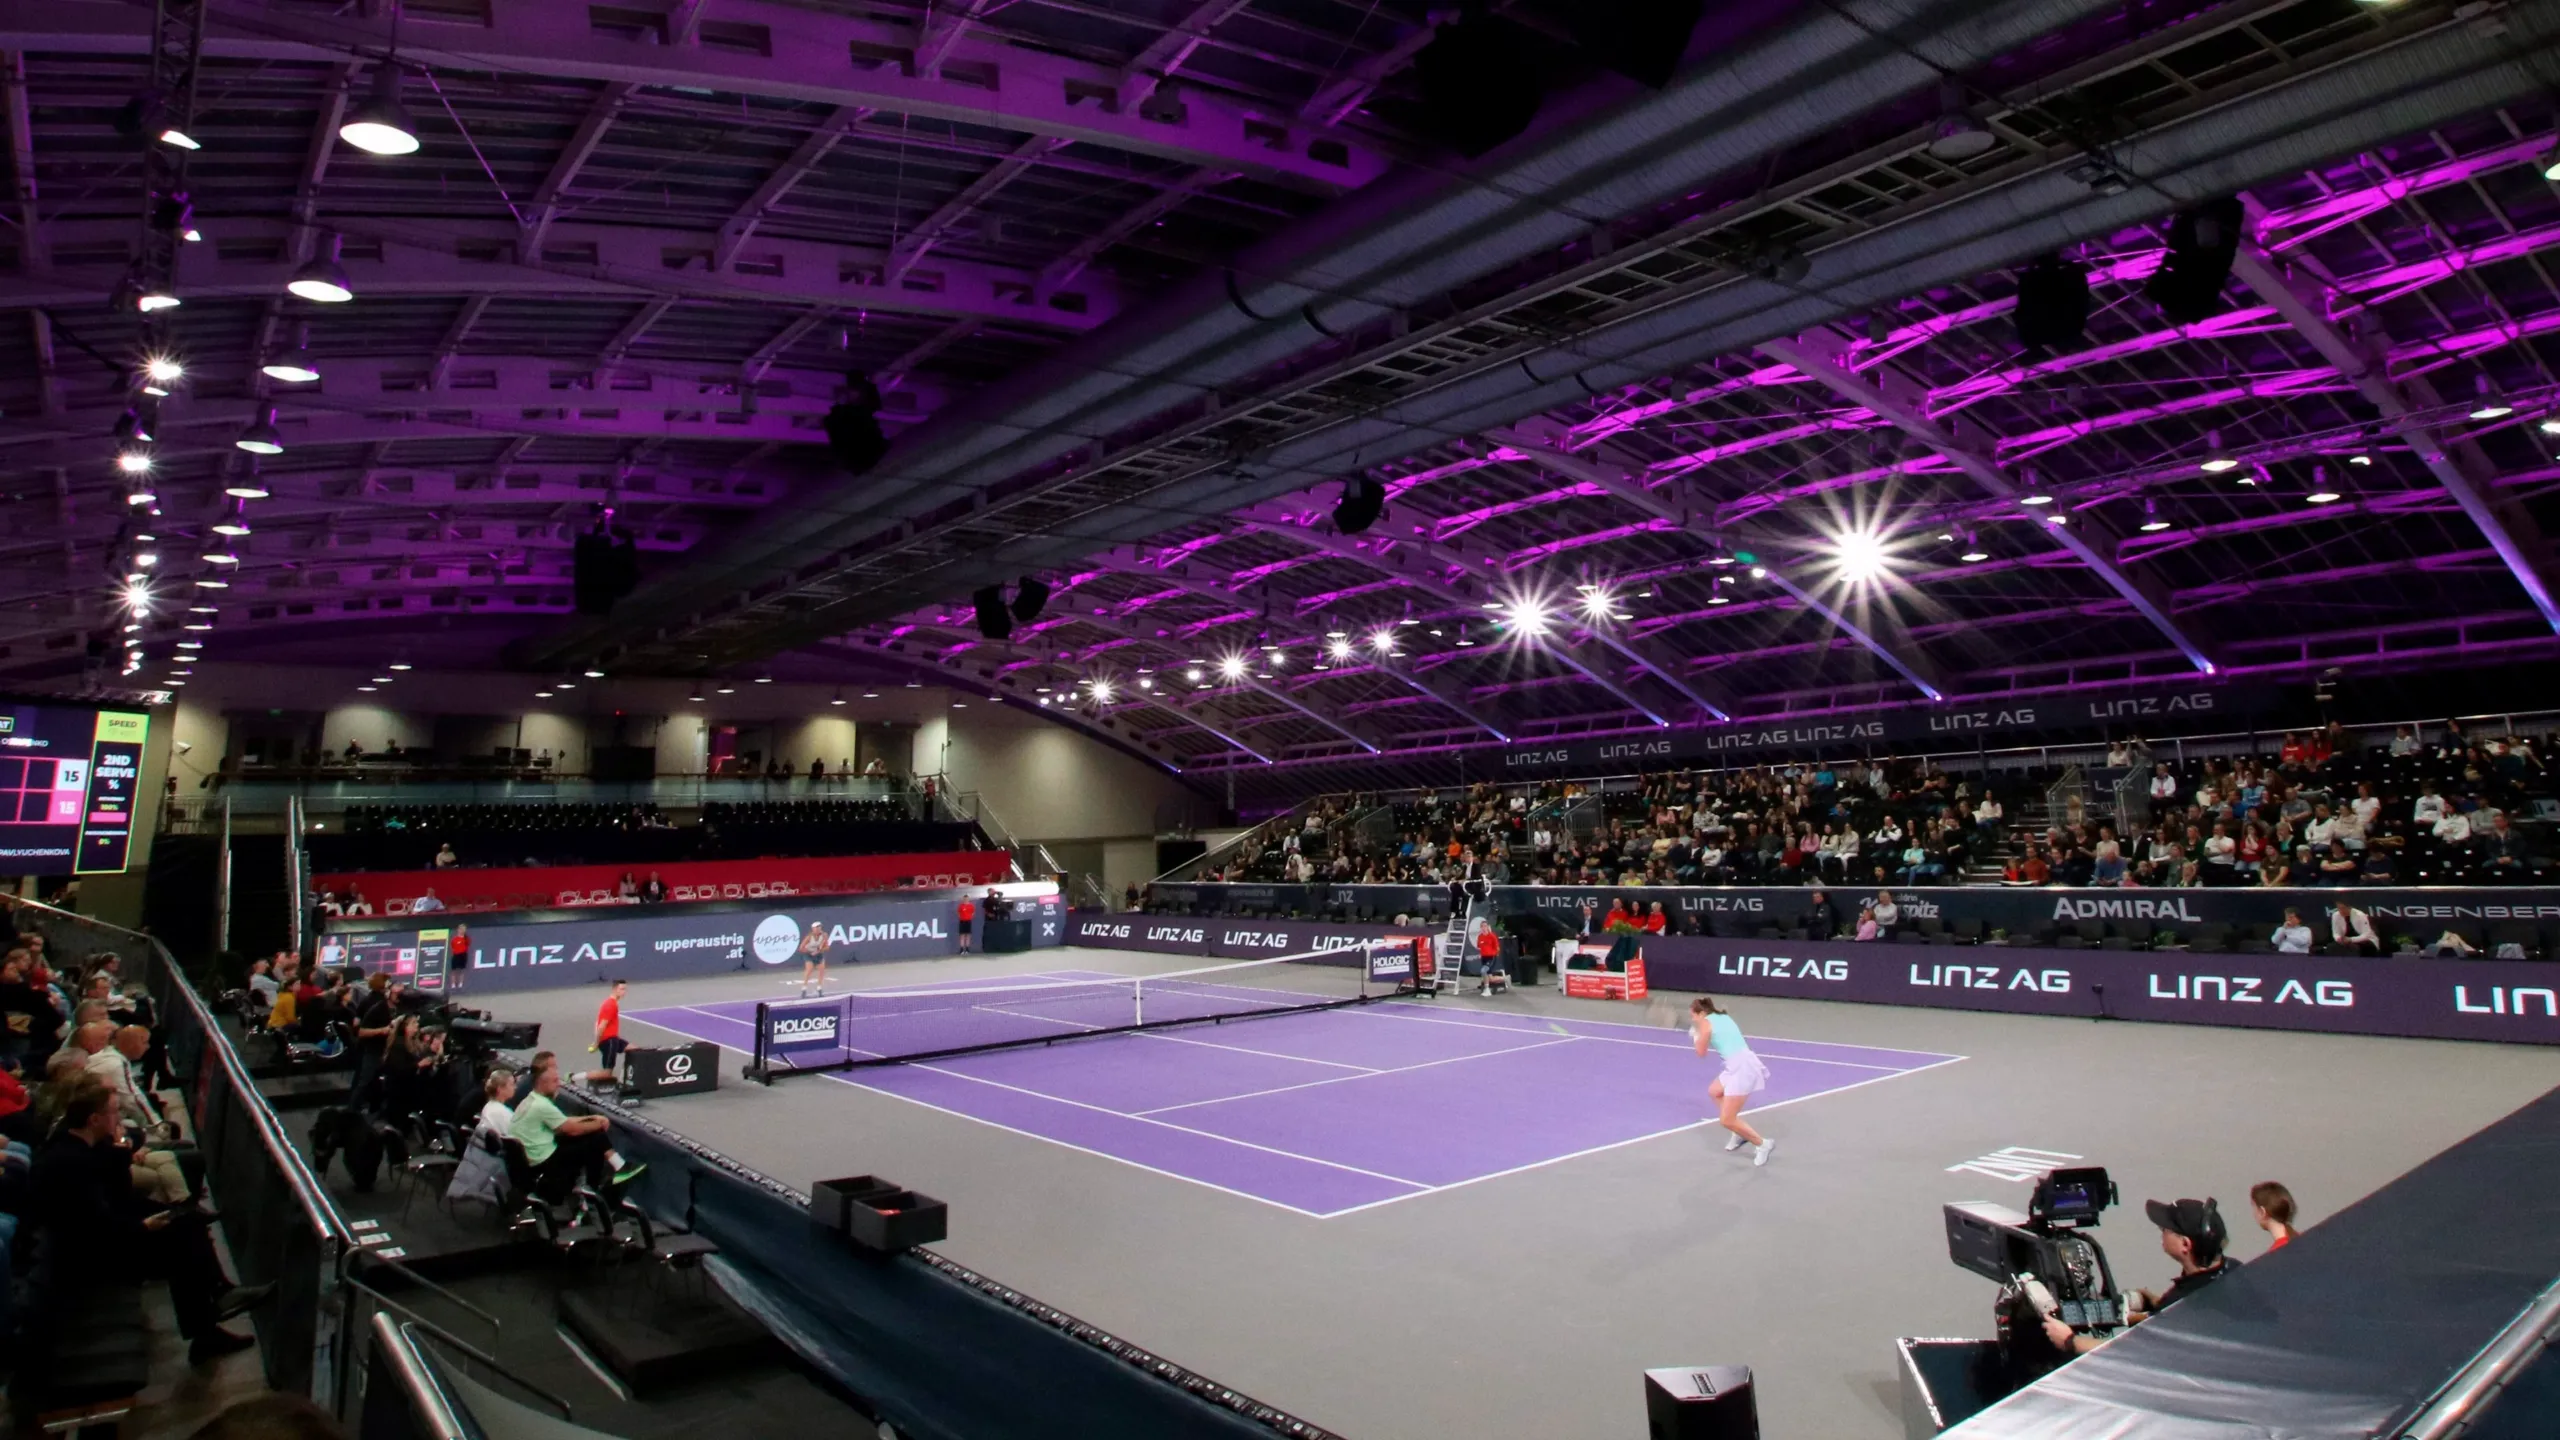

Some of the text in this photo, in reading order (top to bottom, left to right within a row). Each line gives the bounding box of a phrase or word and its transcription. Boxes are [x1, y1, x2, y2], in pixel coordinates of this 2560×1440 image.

[2090, 692, 2213, 718] LINZ AG
[109, 719, 137, 728] SPEED
[1930, 708, 2035, 731] LINZ AG
[1707, 730, 1788, 750] LINZ AG
[1794, 722, 1884, 742] LINZ AG
[1506, 750, 1568, 767] LINZ AG
[1600, 741, 1671, 759] LINZ AG
[104, 755, 131, 766] 2ND
[64, 770, 80, 782] 15
[96, 767, 136, 778] SERVE
[59, 801, 76, 815] 15
[1537, 896, 1598, 908] LINZ AG
[1682, 898, 1764, 912] LINZ AG
[2052, 897, 2202, 922] ADMIRAL
[828, 918, 948, 946] ADMIRAL
[1081, 923, 1130, 938] LINZ AG
[1147, 926, 1204, 943] LINZ AG
[654, 932, 744, 954] upperaustria
[1223, 931, 1288, 948] LINZ AG
[474, 944, 564, 969] LINZ
[572, 940, 627, 962] AG
[1373, 955, 1409, 968] HOLOGIC
[1719, 955, 1848, 980] LINZ AG
[1910, 964, 2071, 993] LINZ AG
[2149, 974, 2354, 1007] LINZ AG
[774, 1016, 838, 1034] HOLOGIC
[658, 1073, 698, 1085] LEXUS
